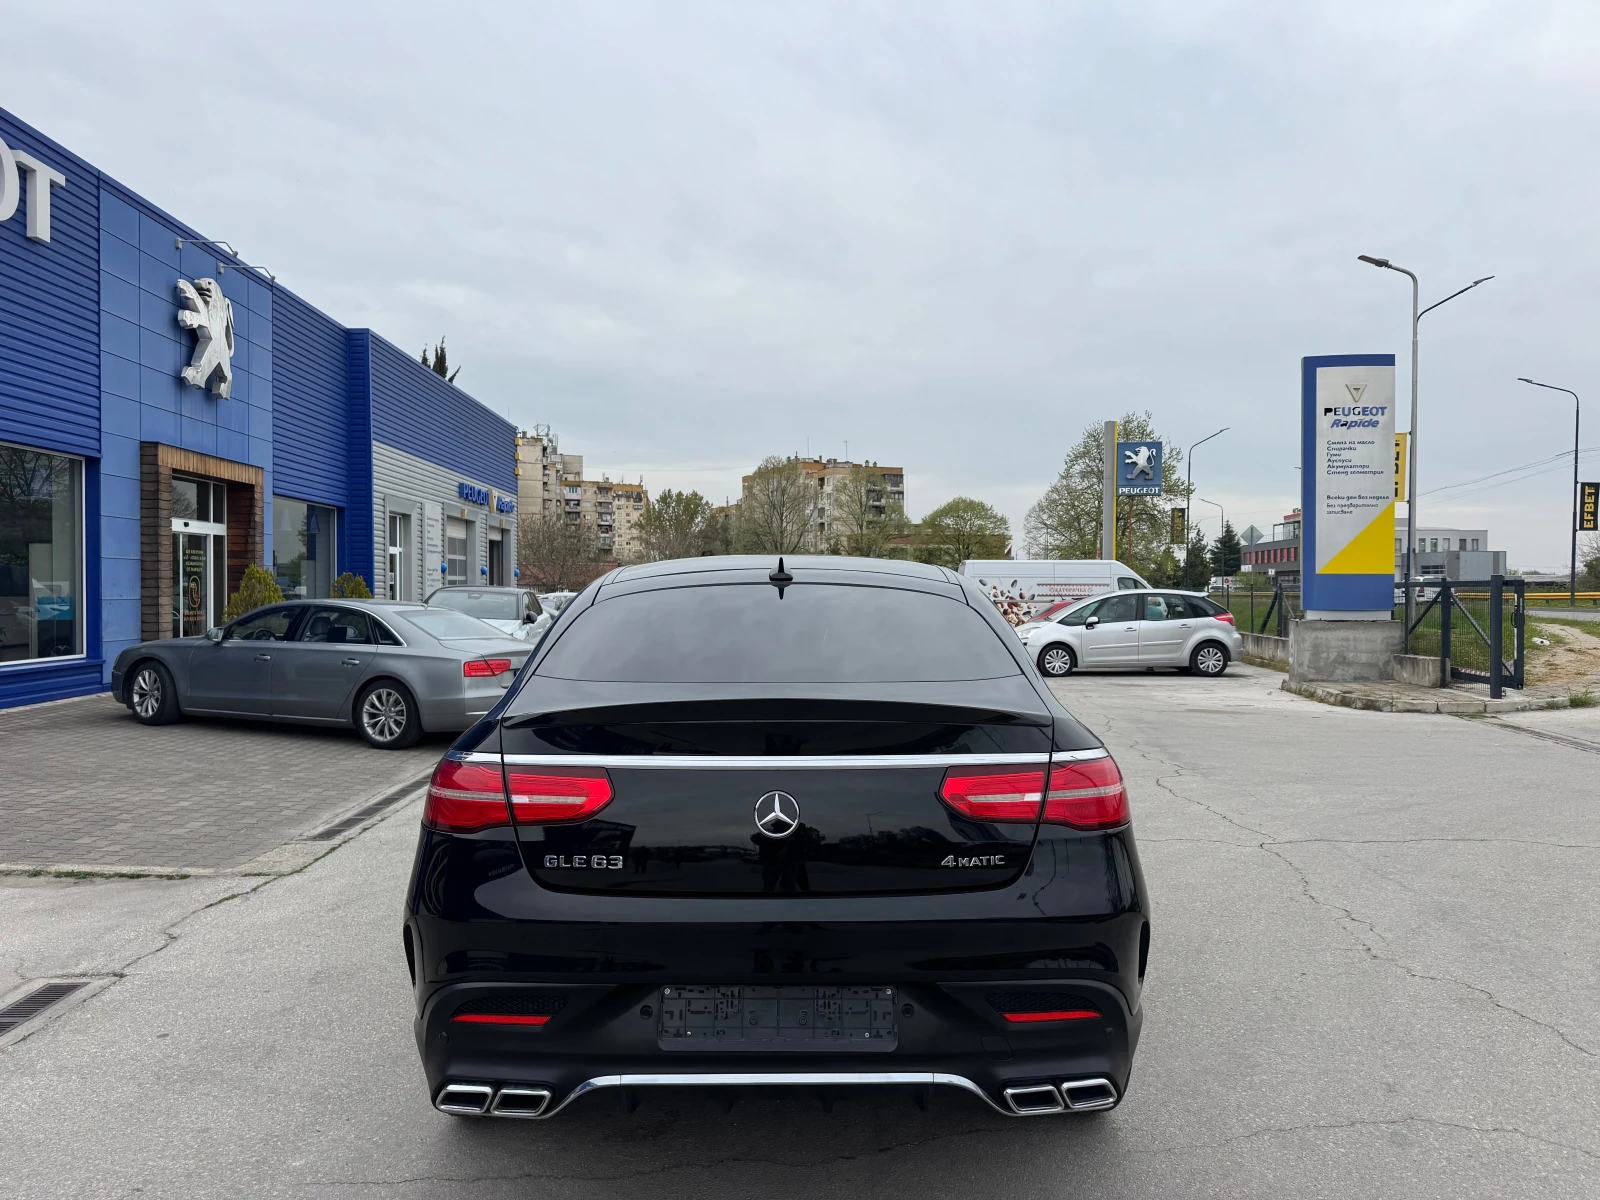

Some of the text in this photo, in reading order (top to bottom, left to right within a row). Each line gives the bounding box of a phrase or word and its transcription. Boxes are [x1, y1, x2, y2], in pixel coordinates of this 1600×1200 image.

[1324, 406, 1388, 416] PEUGEOT
[1331, 418, 1380, 430] Rapide
[1119, 486, 1160, 494] PEUGEOT
[1583, 485, 1596, 529] EFBET
[543, 854, 623, 869] GLE 63
[940, 854, 1006, 868] 4MATIC
